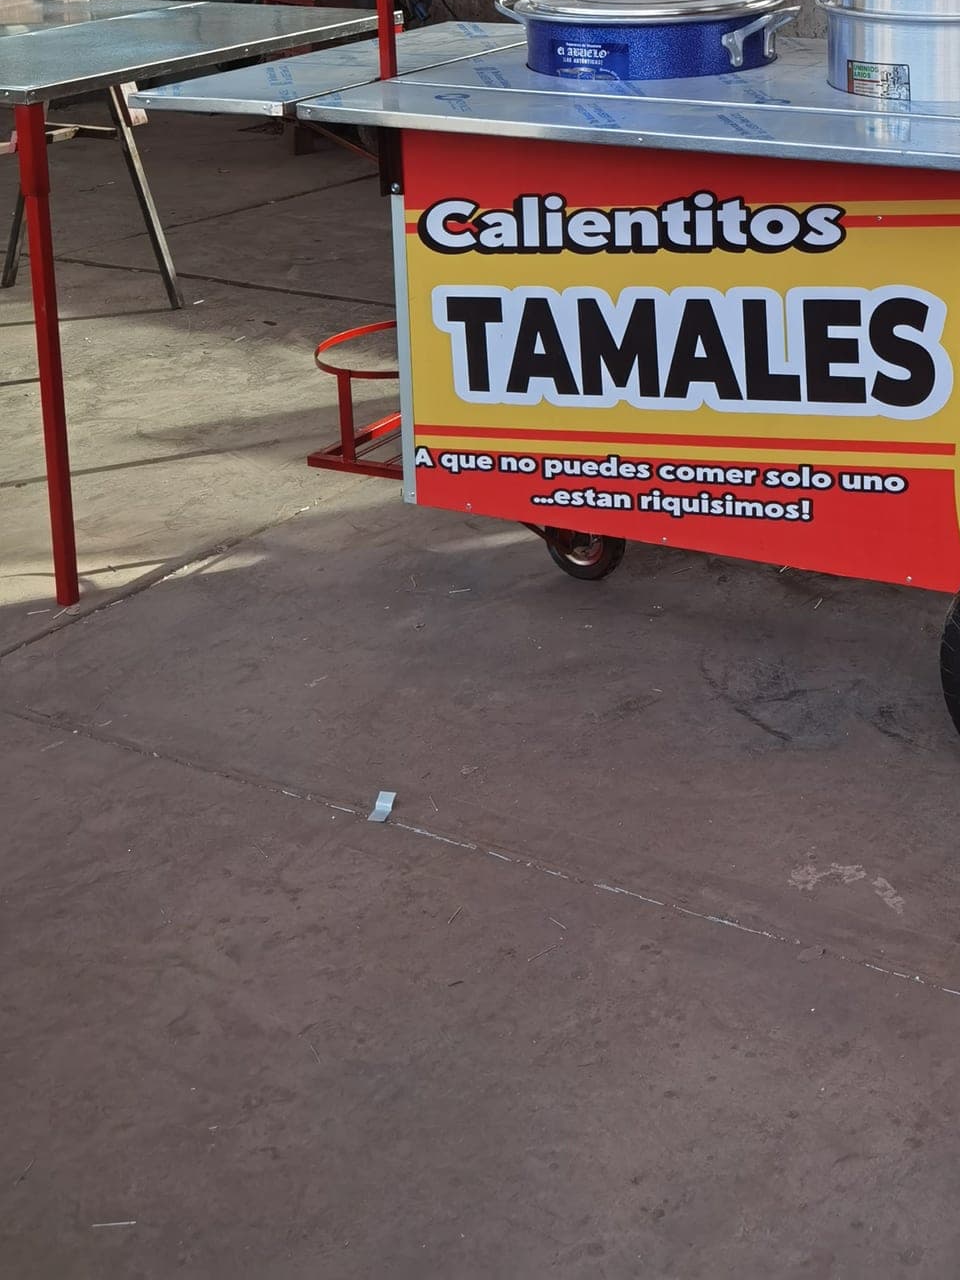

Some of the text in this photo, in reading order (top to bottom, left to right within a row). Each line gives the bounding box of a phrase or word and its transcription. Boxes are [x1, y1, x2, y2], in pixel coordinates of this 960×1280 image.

[418, 191, 846, 254] Calientitos
[440, 292, 942, 412] TAMALES
[415, 447, 906, 493] A que no puedes comer solo uno
[533, 489, 811, 520] ...estan riquisimos!
